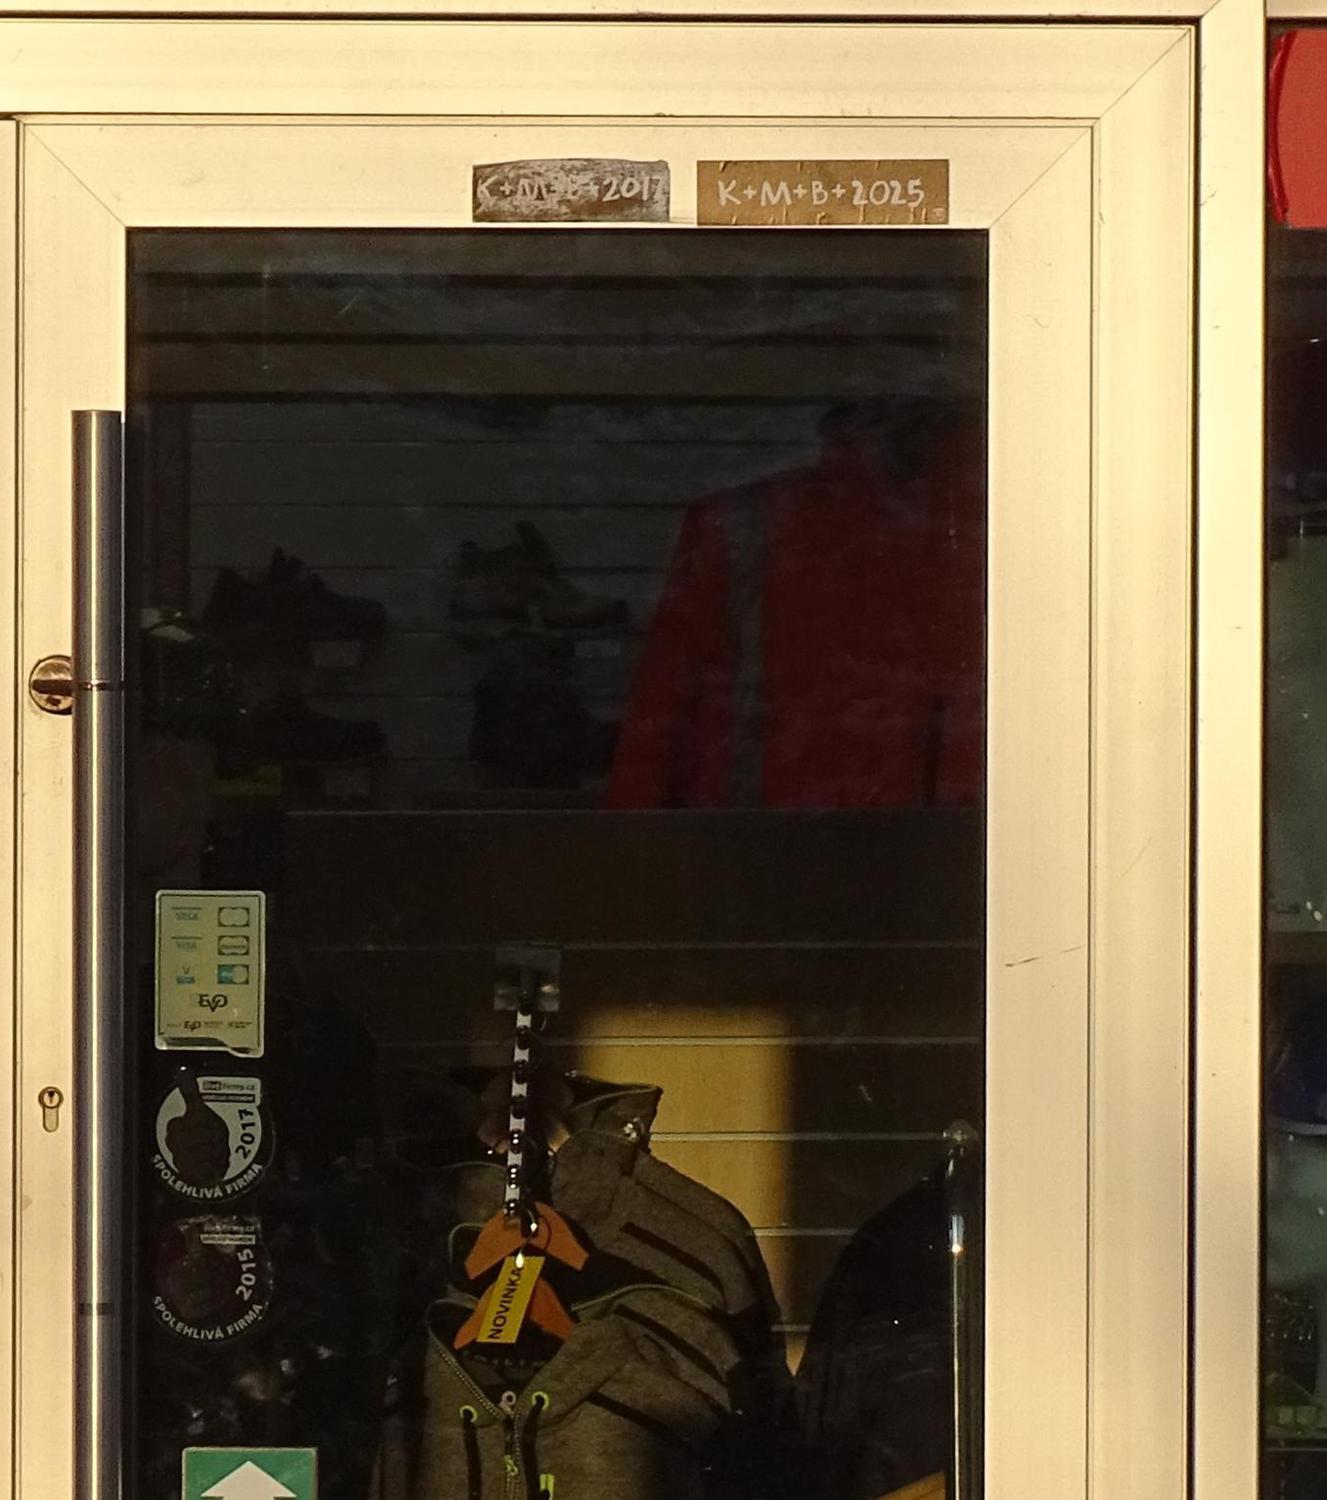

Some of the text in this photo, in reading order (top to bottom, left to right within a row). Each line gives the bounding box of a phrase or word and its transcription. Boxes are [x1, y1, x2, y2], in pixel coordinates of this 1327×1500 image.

[717, 179, 926, 207] K+M+B+2025
[235, 1107, 255, 1159] 2017
[226, 1163, 263, 1196] FIRMA
[235, 1248, 256, 1301] 2015
[226, 1303, 263, 1336] FIRMA
[487, 1264, 524, 1341] NOVINKA
